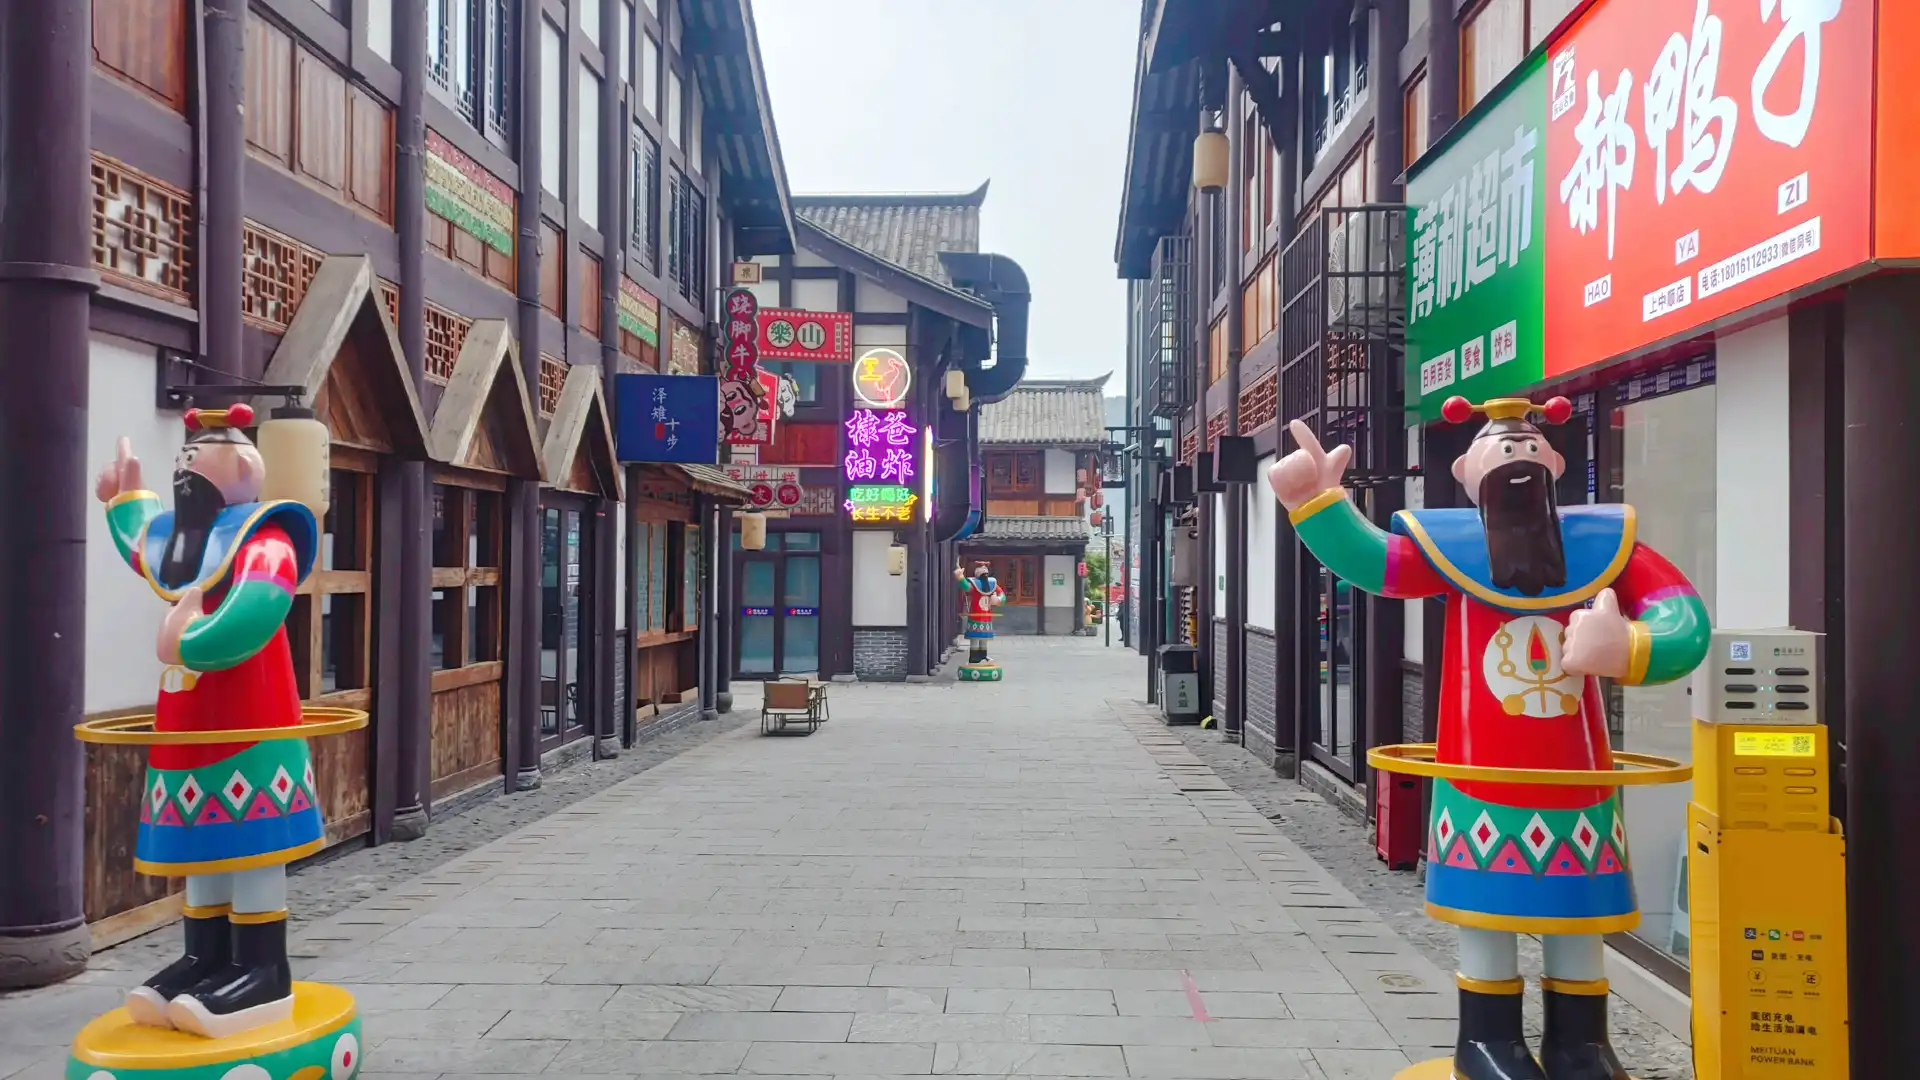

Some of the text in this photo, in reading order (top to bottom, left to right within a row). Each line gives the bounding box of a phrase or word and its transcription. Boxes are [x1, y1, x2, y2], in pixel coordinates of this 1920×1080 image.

[1784, 179, 1801, 207] ZI
[1410, 124, 1538, 324] 薄利超市
[1679, 236, 1696, 259] YA
[1586, 280, 1609, 303] HAO
[1649, 283, 1685, 315] 上中顺店
[1494, 328, 1513, 359] 饮料
[1464, 344, 1481, 371] 零食
[664, 417, 680, 451] 十步
[845, 448, 914, 485] 油炸
[850, 487, 910, 502] 吃好喝好
[851, 504, 911, 521] 长生不老
[1750, 1045, 1796, 1056] MEITUAN
[1750, 1055, 1815, 1068] POWER BANK
